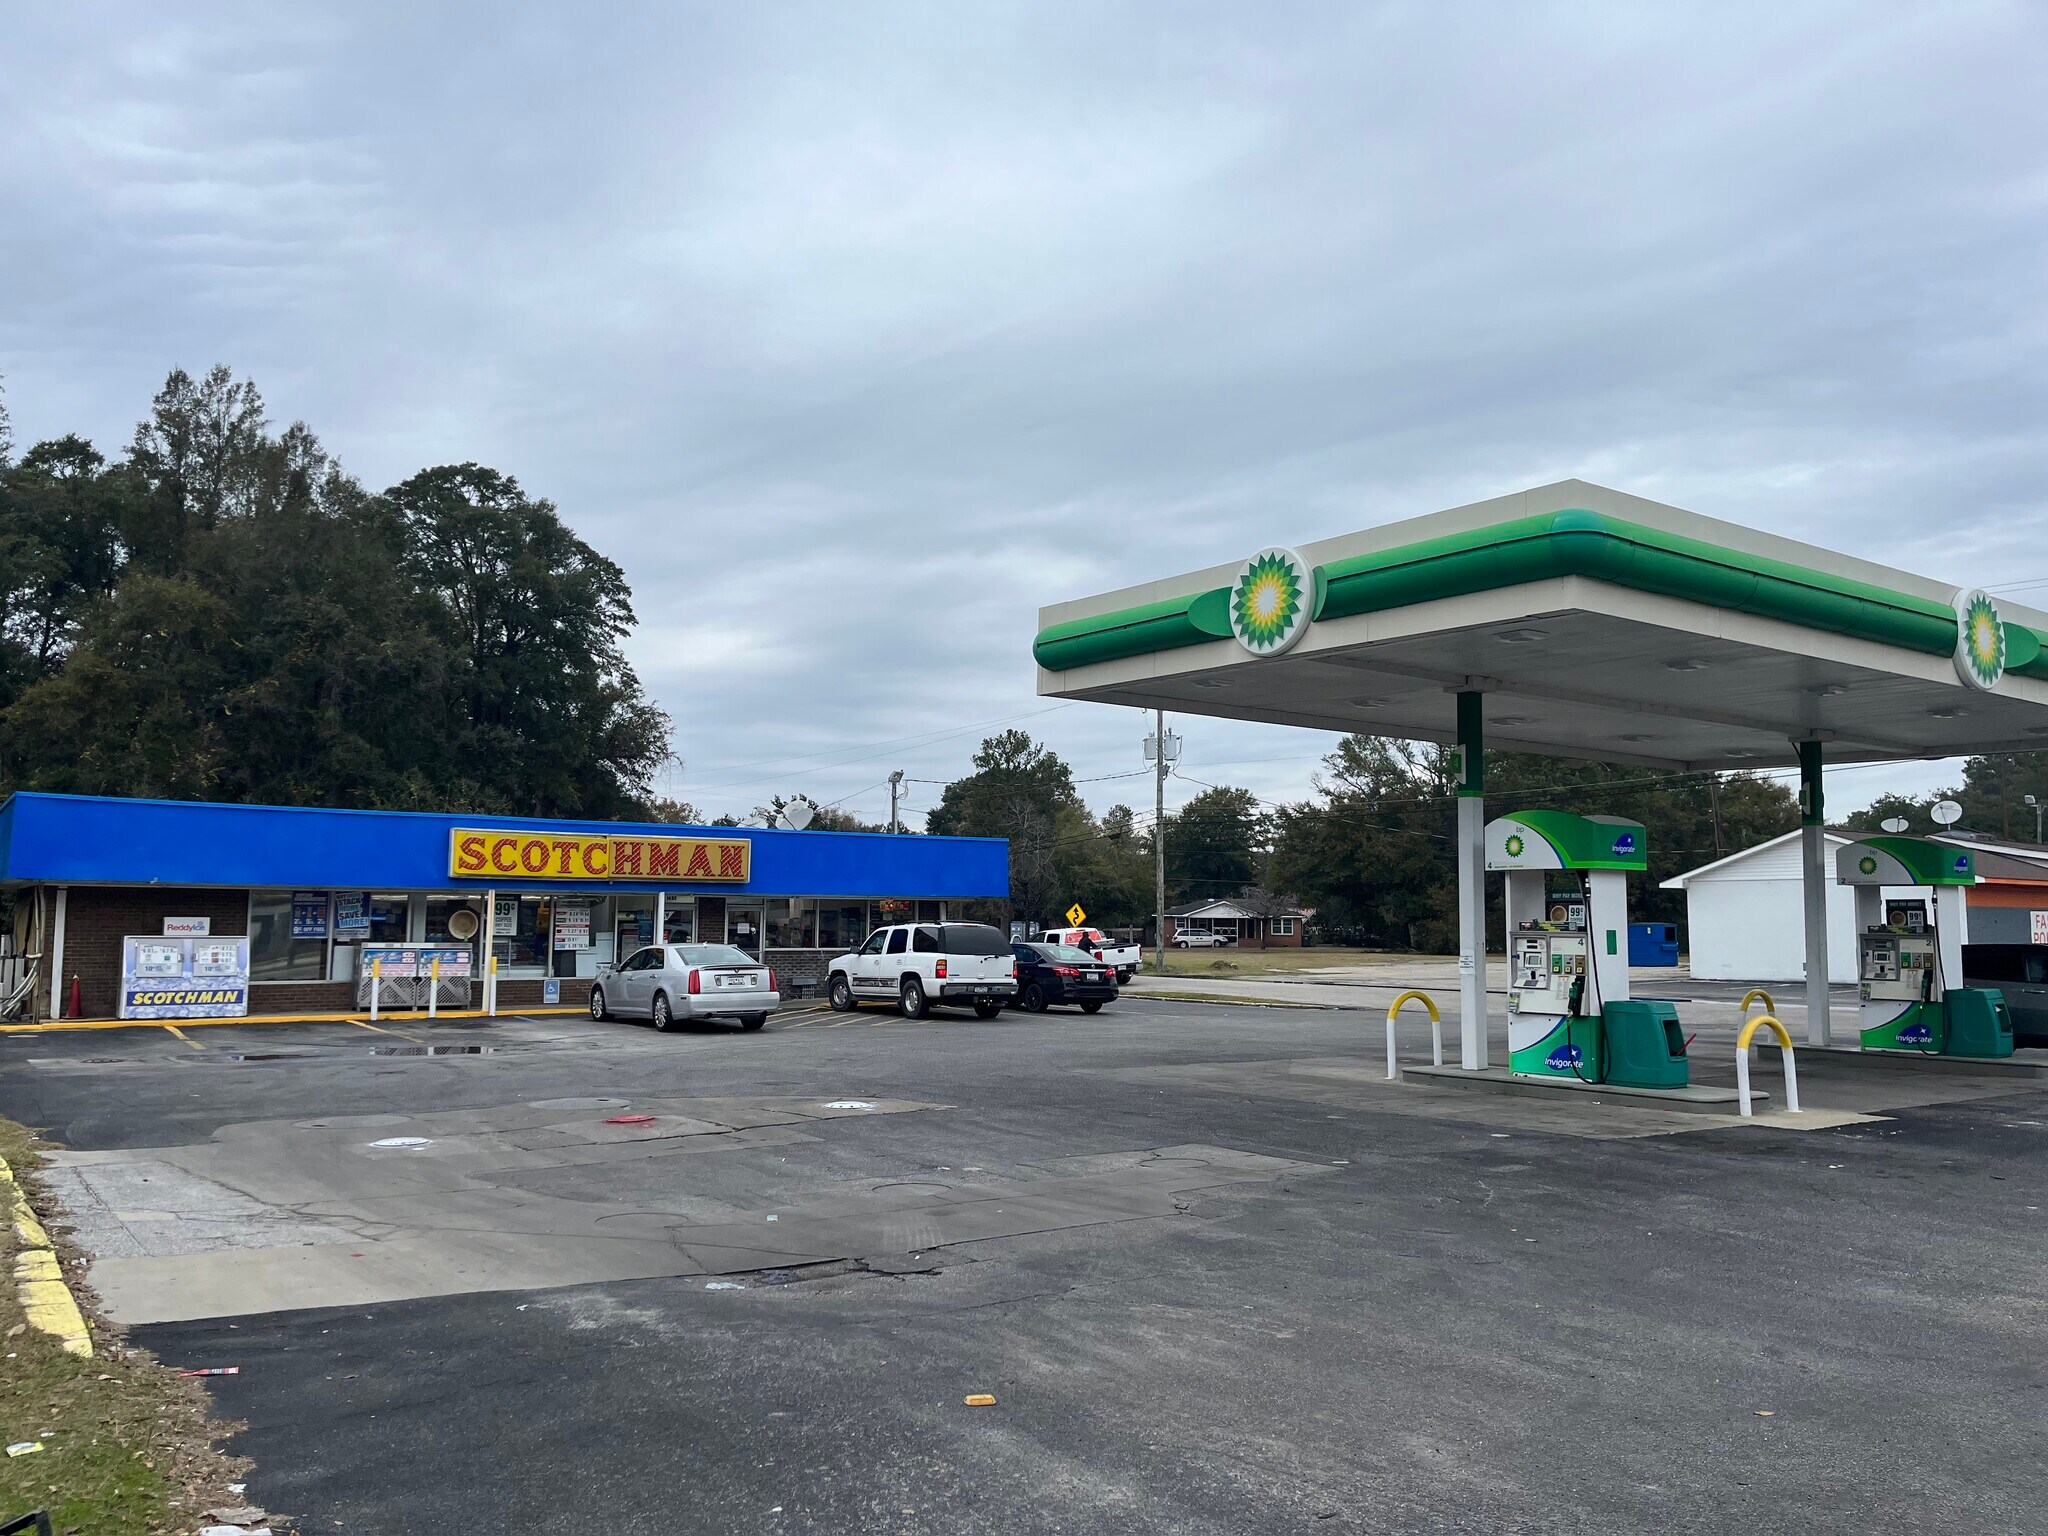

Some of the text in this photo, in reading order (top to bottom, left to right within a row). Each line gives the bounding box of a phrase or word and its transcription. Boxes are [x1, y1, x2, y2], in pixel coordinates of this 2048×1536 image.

[458, 836, 746, 877] SCOTCHMAN
[338, 897, 362, 906] STACK
[495, 902, 516, 916] 99¢
[339, 911, 360, 920] SAVE
[340, 918, 368, 927] MORE!
[2035, 914, 2048, 929] FA
[1578, 938, 1584, 947] 4
[132, 990, 239, 1005] SCOTCHMAN
